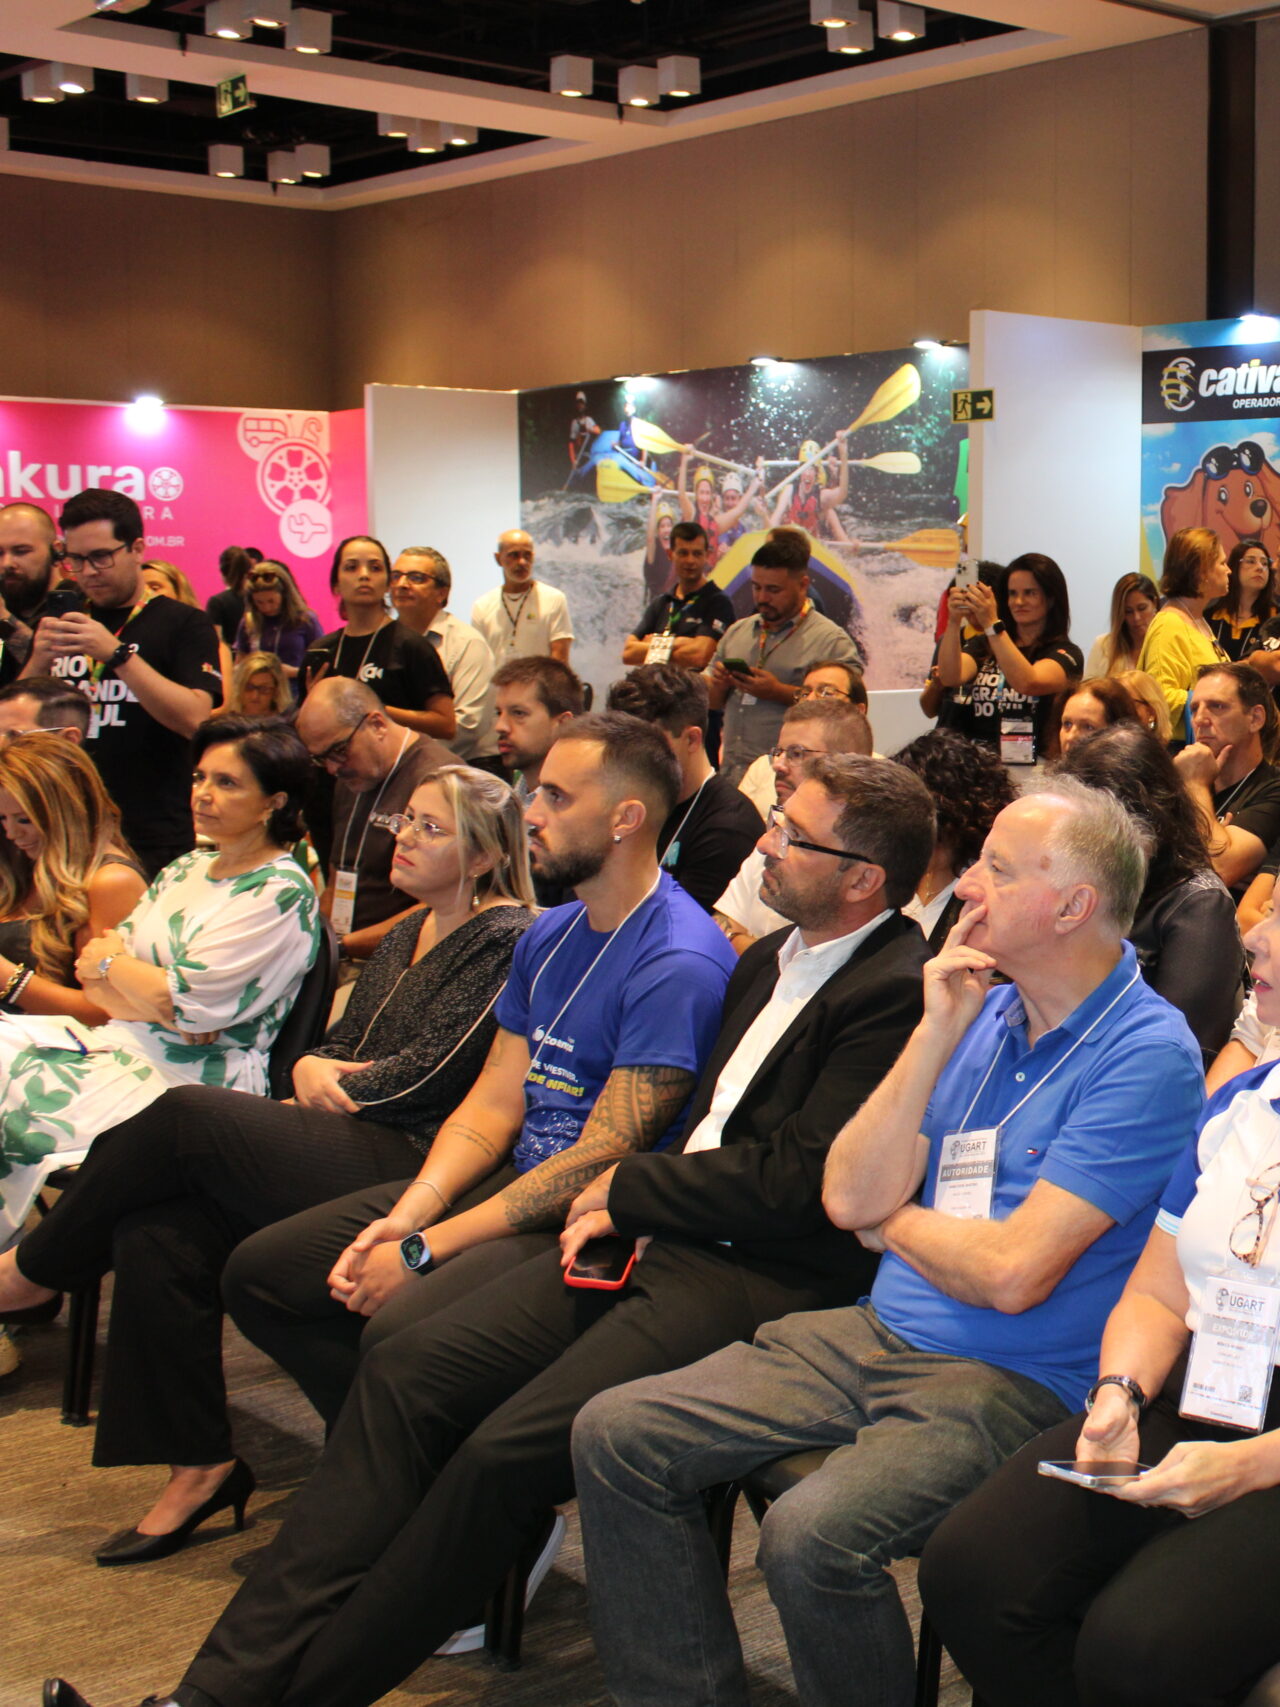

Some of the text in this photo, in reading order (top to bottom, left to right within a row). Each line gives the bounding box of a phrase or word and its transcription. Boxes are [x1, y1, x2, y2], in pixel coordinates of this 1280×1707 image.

[0, 450, 145, 500] kura
[973, 672, 999, 687] RIO
[974, 702, 995, 717] DO
[960, 1141, 987, 1153] UGART
[942, 1165, 990, 1177] AUTORIDADE
[1229, 1295, 1266, 1313] UGART
